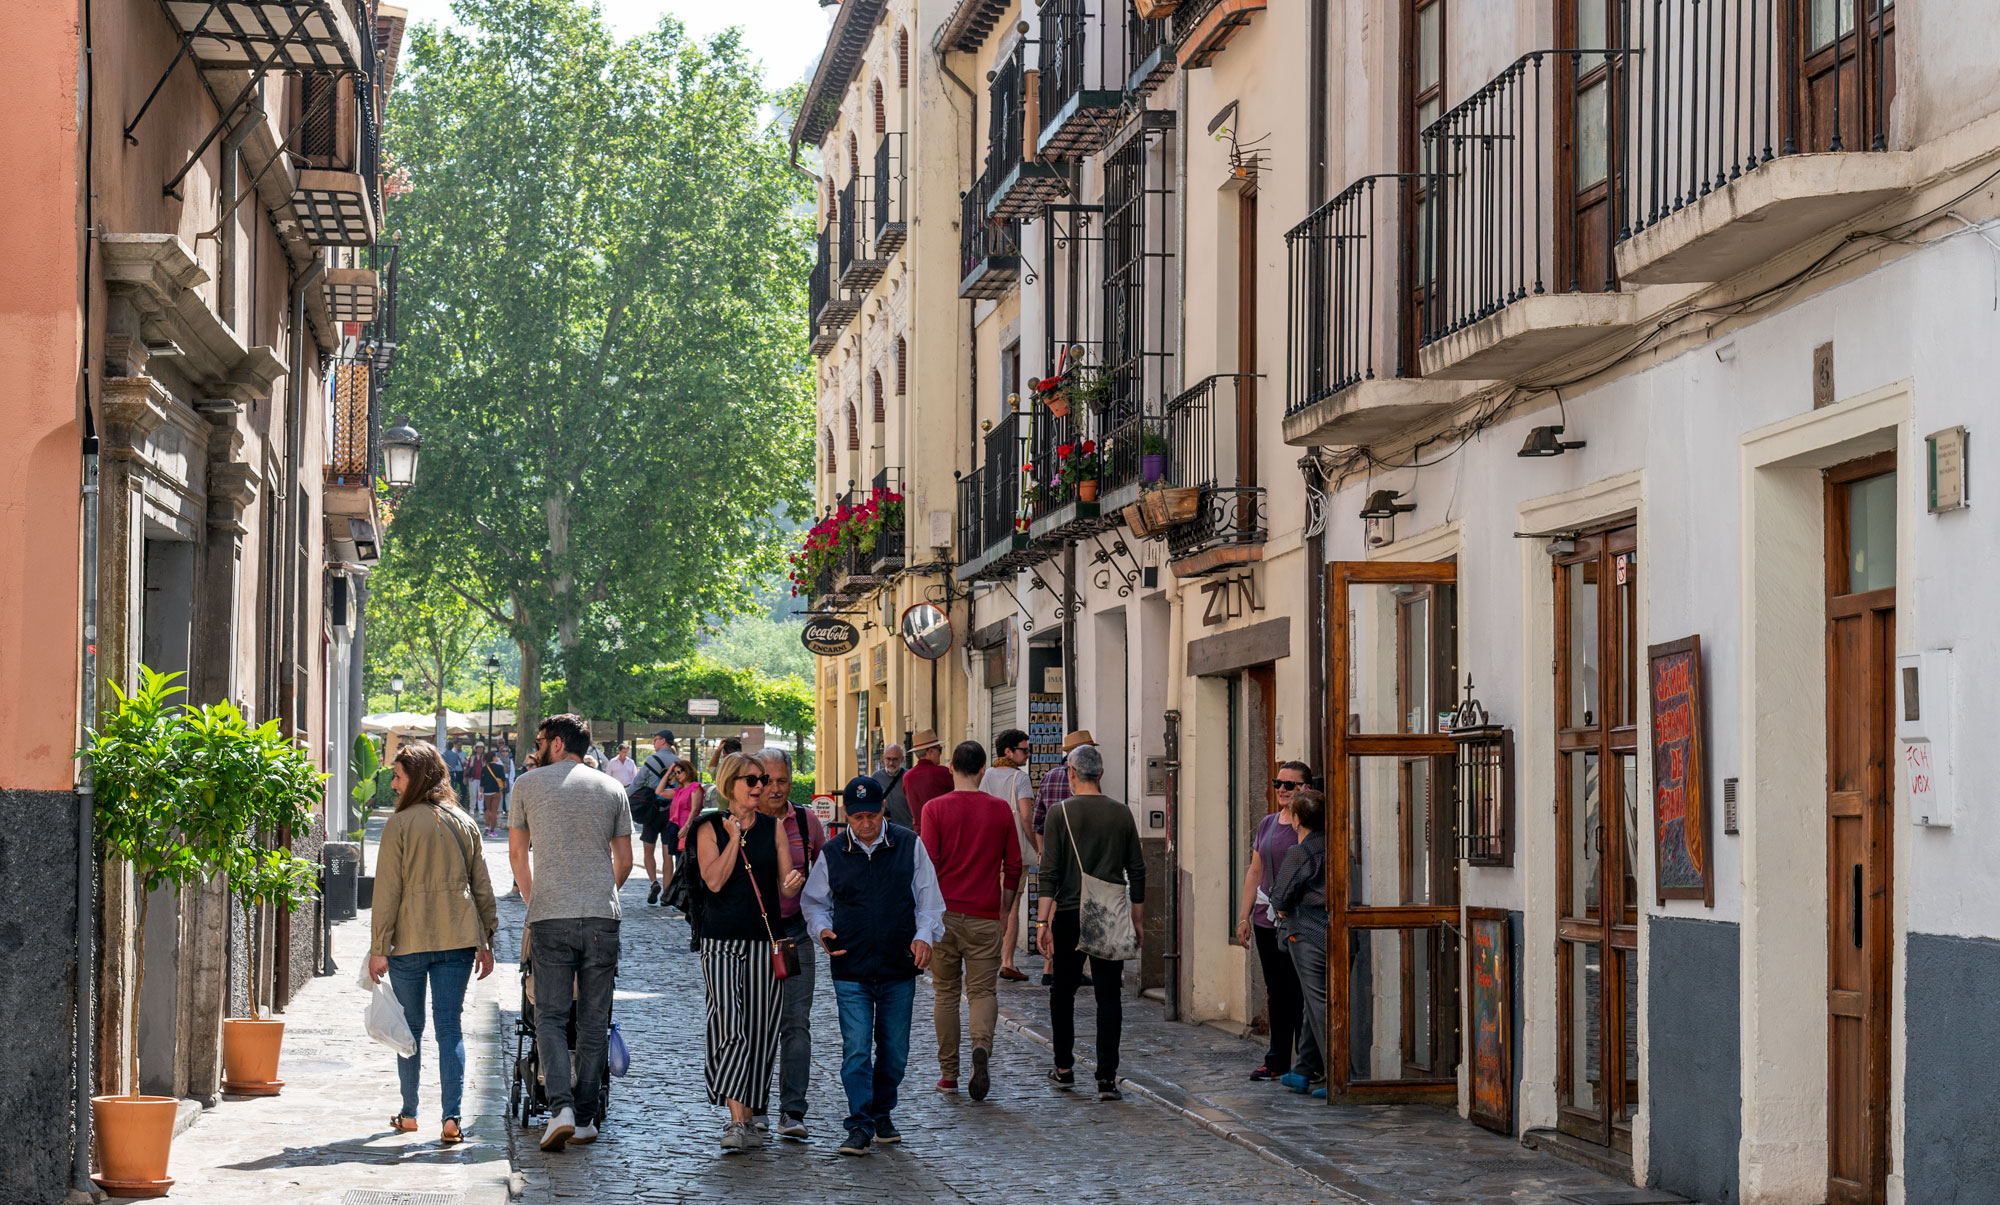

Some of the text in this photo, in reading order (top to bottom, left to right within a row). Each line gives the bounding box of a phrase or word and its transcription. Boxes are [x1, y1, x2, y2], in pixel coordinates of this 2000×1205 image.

[812, 644, 847, 653] ENCARNI
[1656, 702, 1689, 746] SERRANO
[1670, 748, 1683, 780] DE
[1911, 774, 1931, 795] VOX
